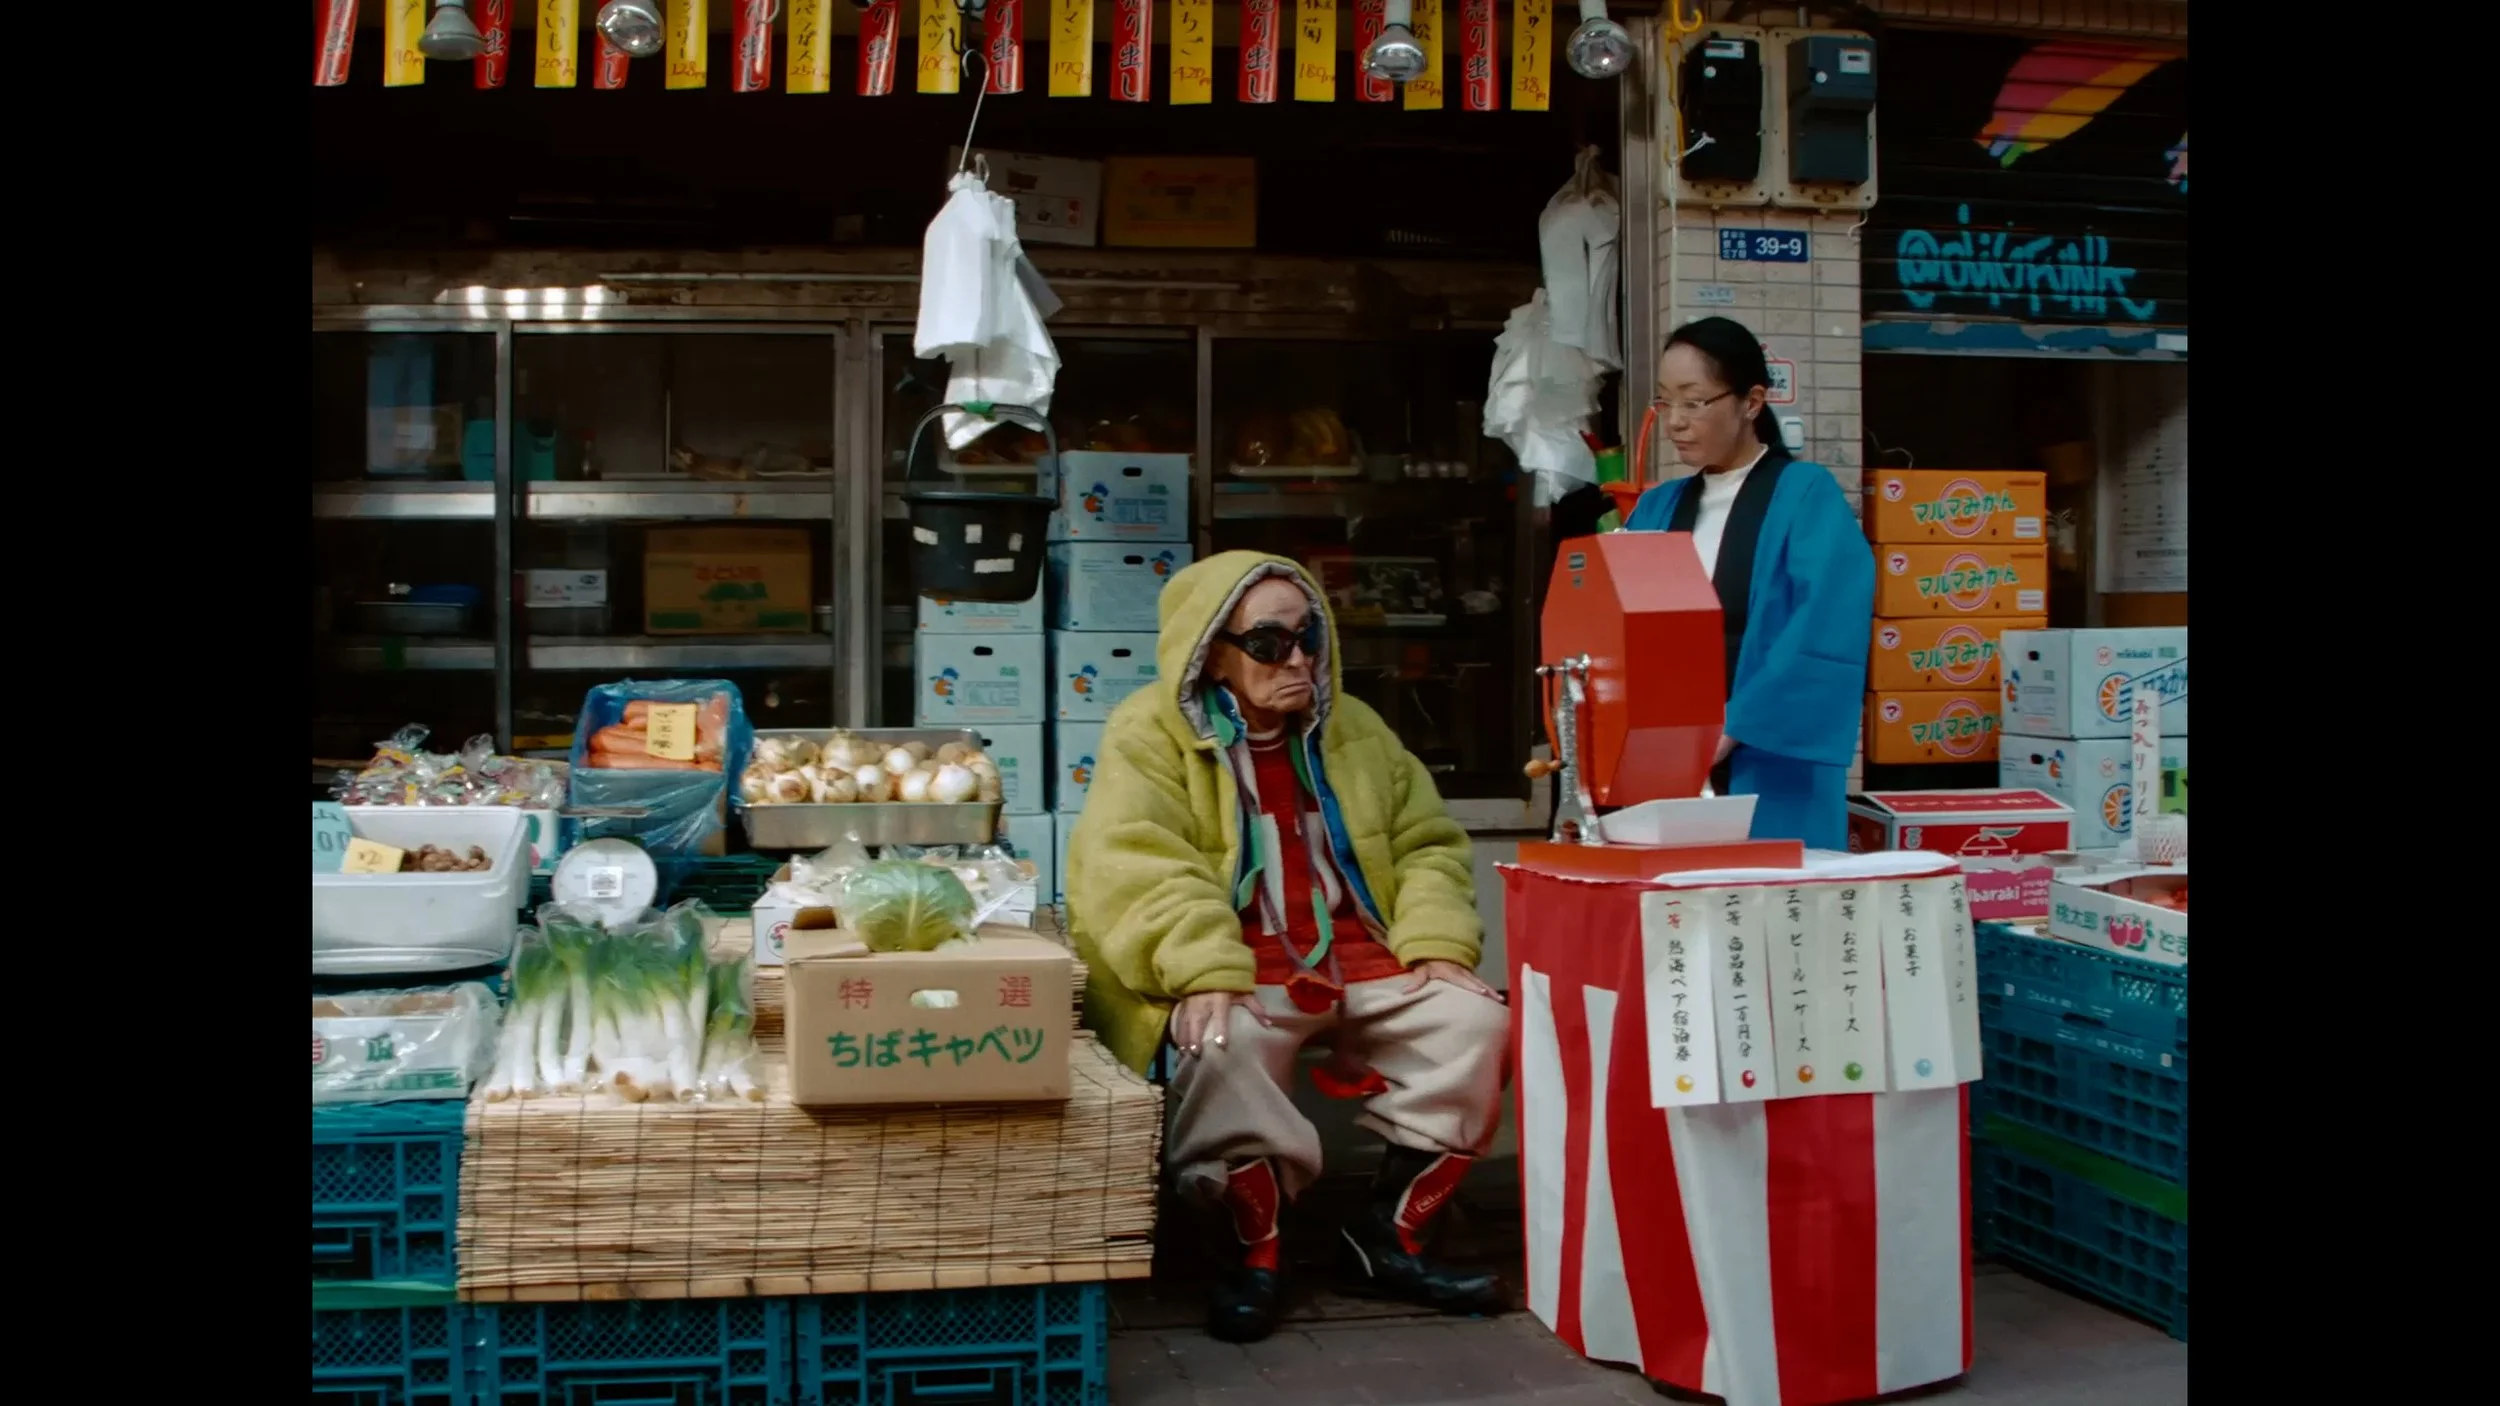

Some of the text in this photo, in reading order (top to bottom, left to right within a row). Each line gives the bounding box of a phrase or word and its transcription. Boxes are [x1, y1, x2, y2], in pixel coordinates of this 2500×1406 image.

[923, 0, 946, 51] ベツ
[1755, 236, 1803, 256] 39-9
[1914, 491, 2016, 523] マルマみかん
[1918, 564, 2018, 598] マルマみかん
[1910, 640, 1999, 672] マルマみか
[1911, 714, 1999, 747] マルマみか
[1665, 899, 1681, 929] 一等
[1725, 893, 1742, 927] 二等
[1785, 888, 1801, 922] 三等
[1840, 888, 1857, 921] 四等
[838, 975, 1032, 1010] 特 選
[827, 1025, 1045, 1068] ちばキャベツ
